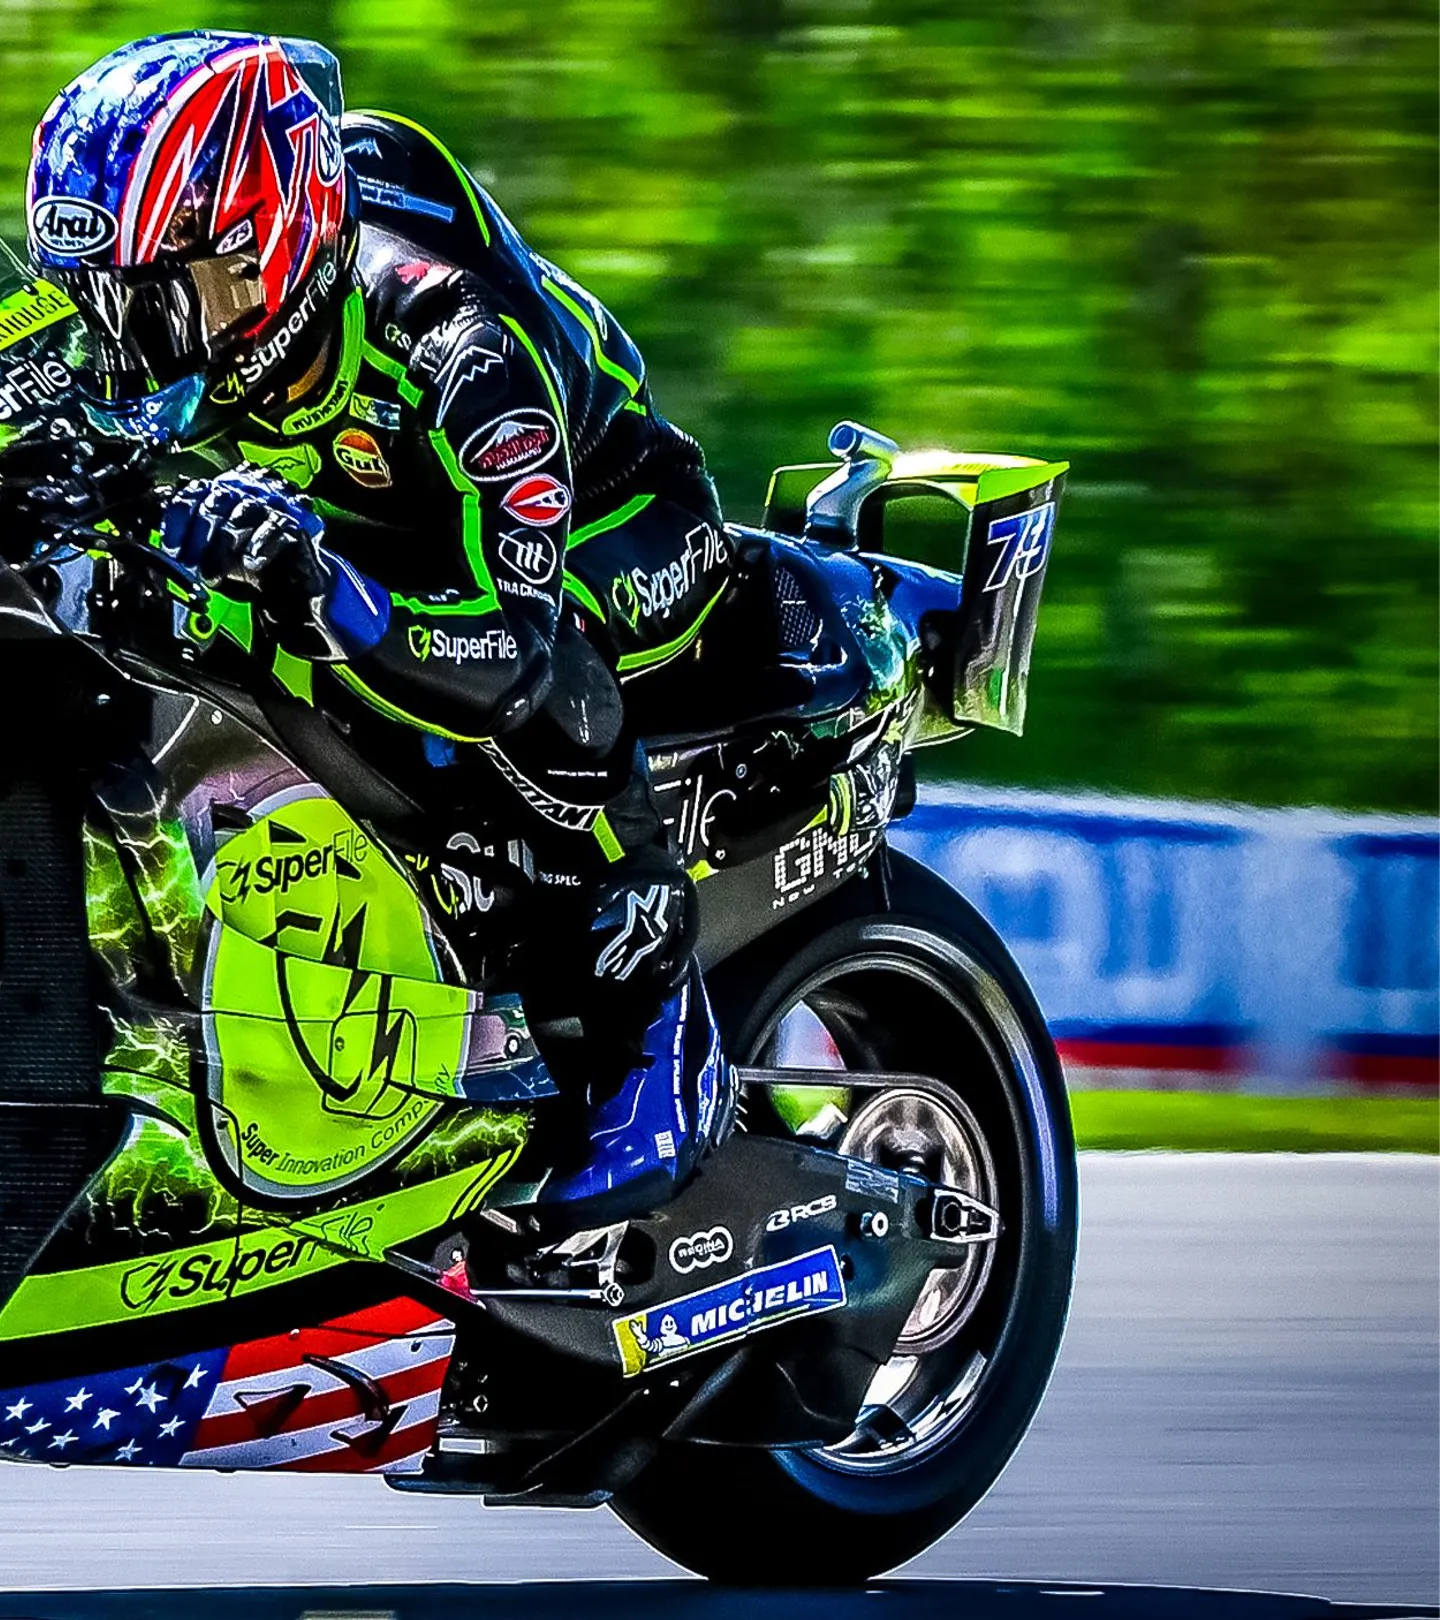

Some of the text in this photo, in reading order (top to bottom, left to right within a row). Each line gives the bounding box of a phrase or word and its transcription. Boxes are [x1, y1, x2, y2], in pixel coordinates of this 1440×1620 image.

[241, 260, 337, 383] SuperFile
[336, 447, 385, 474] Gul
[631, 521, 728, 619] SuperFile
[431, 629, 518, 665] SuperFile
[242, 1122, 280, 1166] Super
[275, 1143, 365, 1175] Innovation
[691, 1270, 828, 1337] MICHELIN
